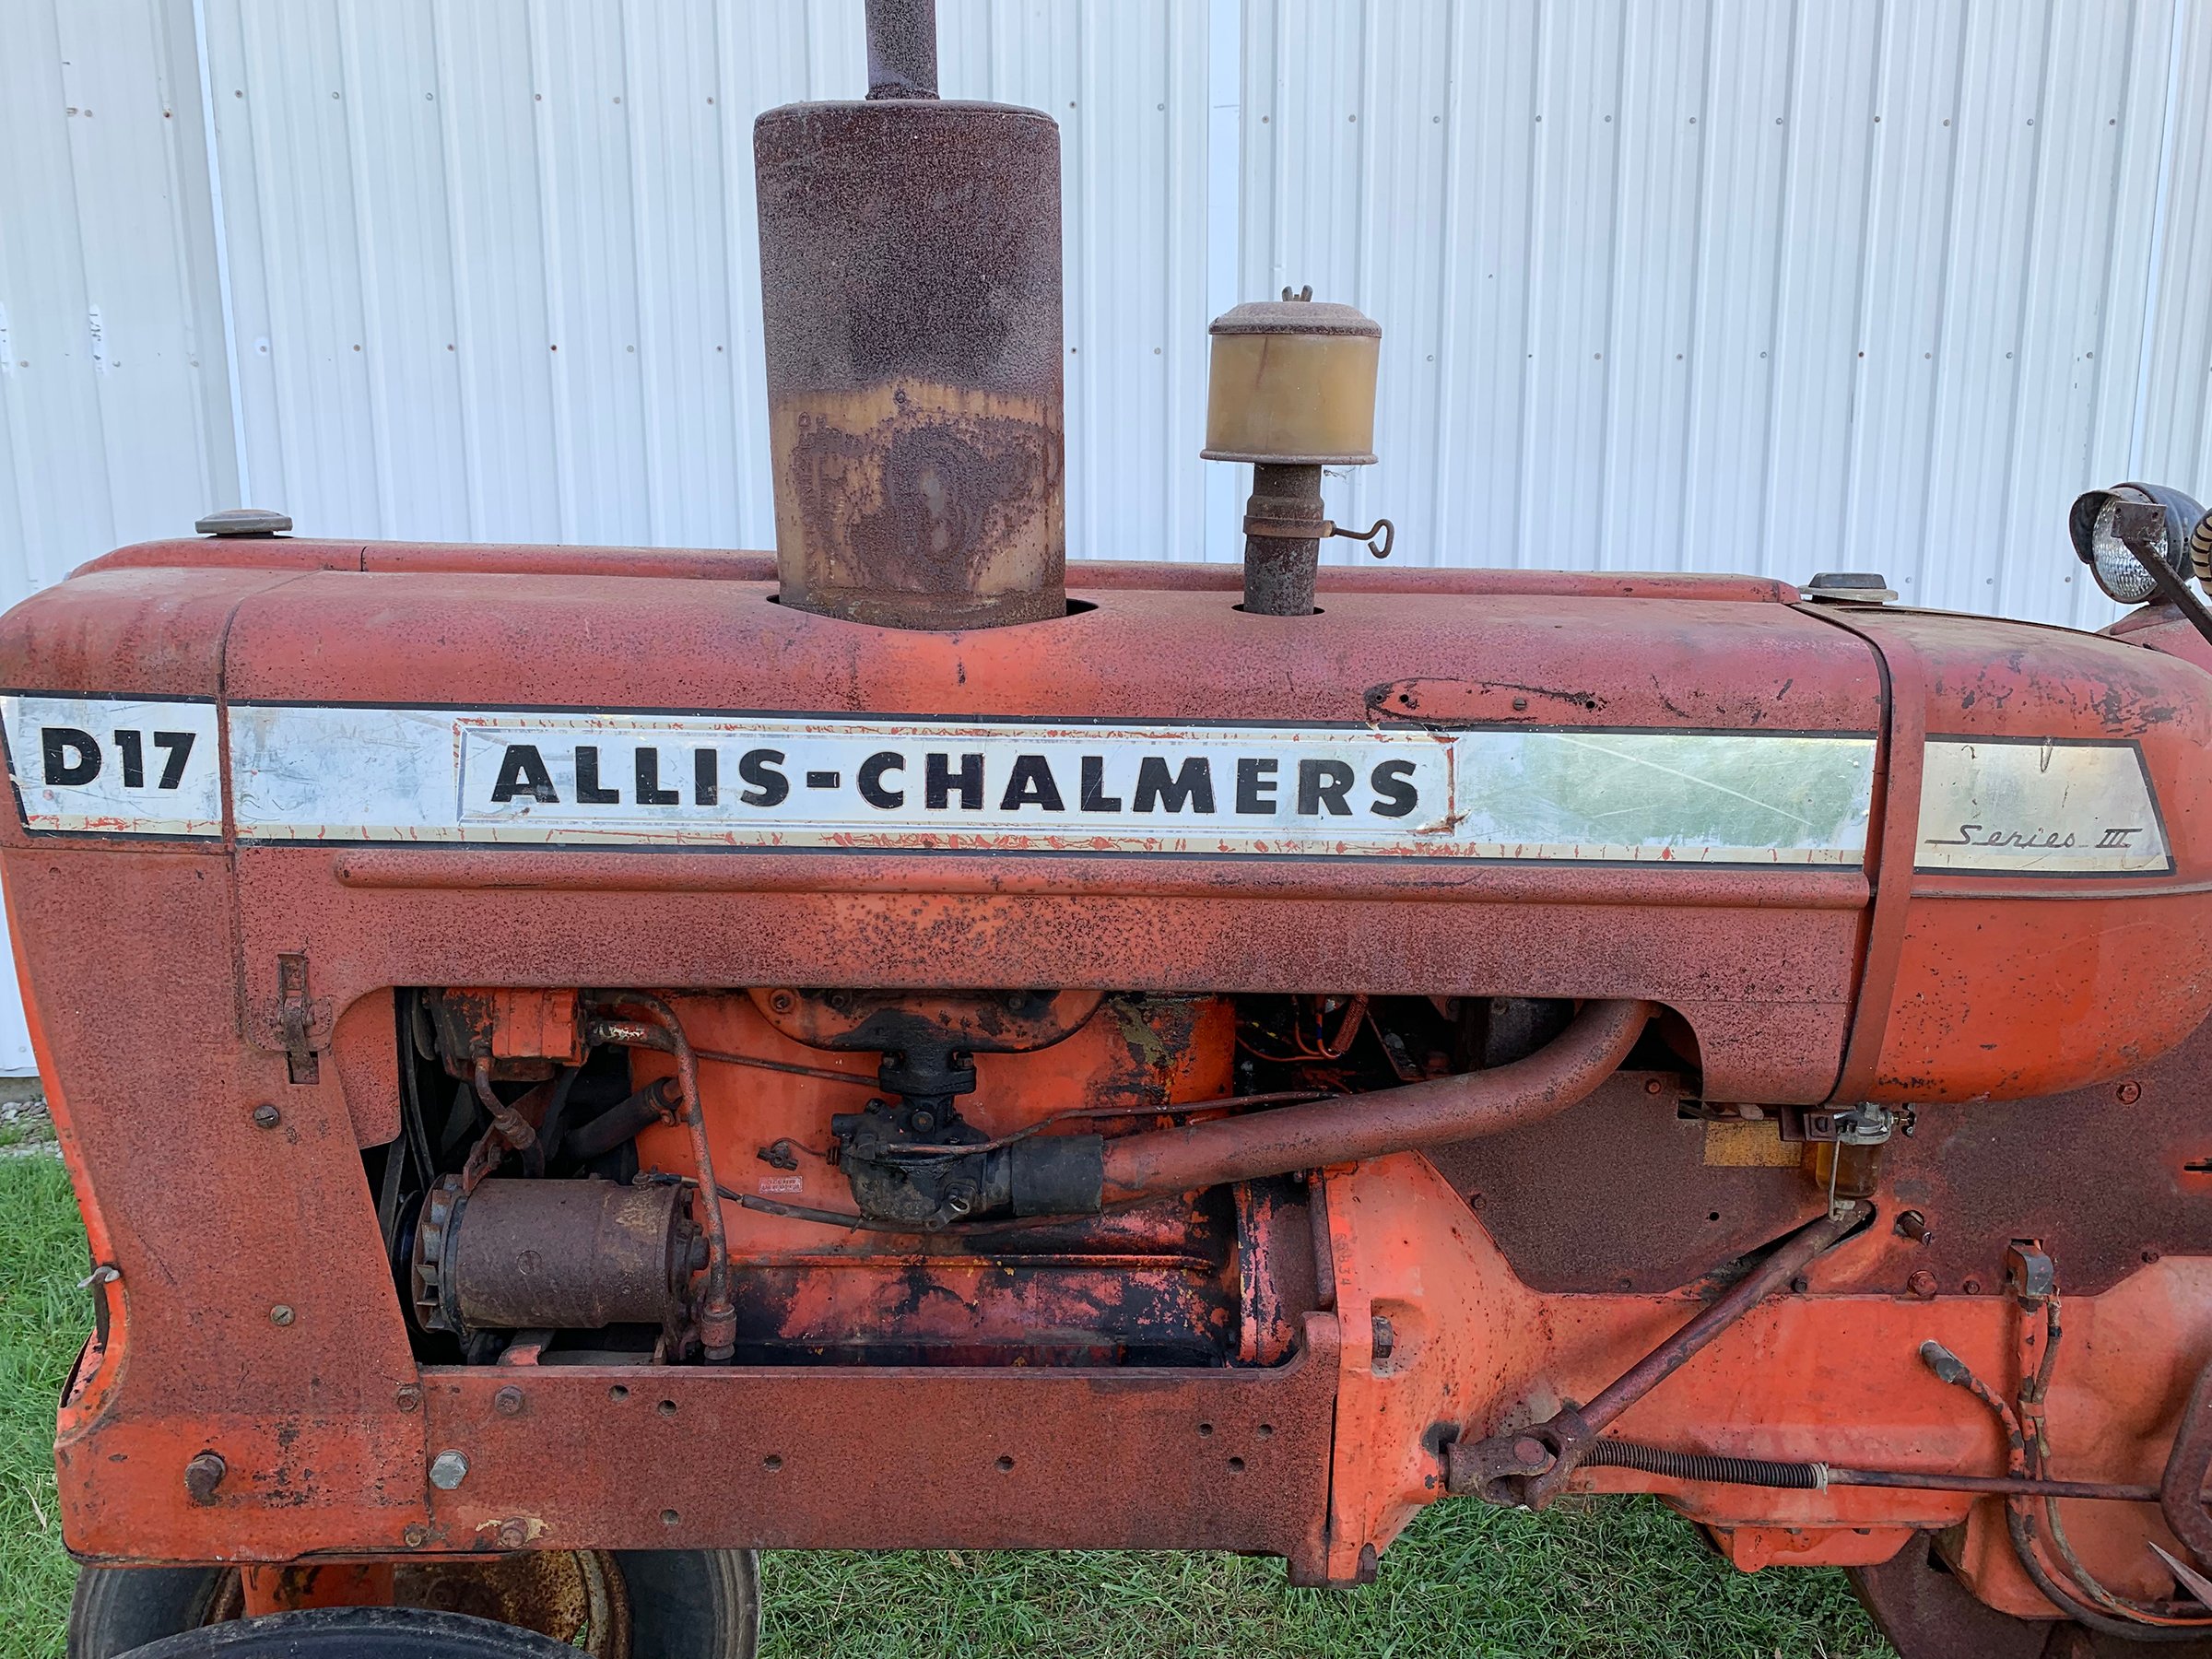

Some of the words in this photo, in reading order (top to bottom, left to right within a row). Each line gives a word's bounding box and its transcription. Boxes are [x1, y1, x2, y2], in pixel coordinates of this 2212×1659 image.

[41, 727, 196, 789] D17
[490, 745, 1418, 818] ALLIS-CHALMERS
[1924, 824, 2075, 849] Series
[2095, 829, 2143, 848] III
